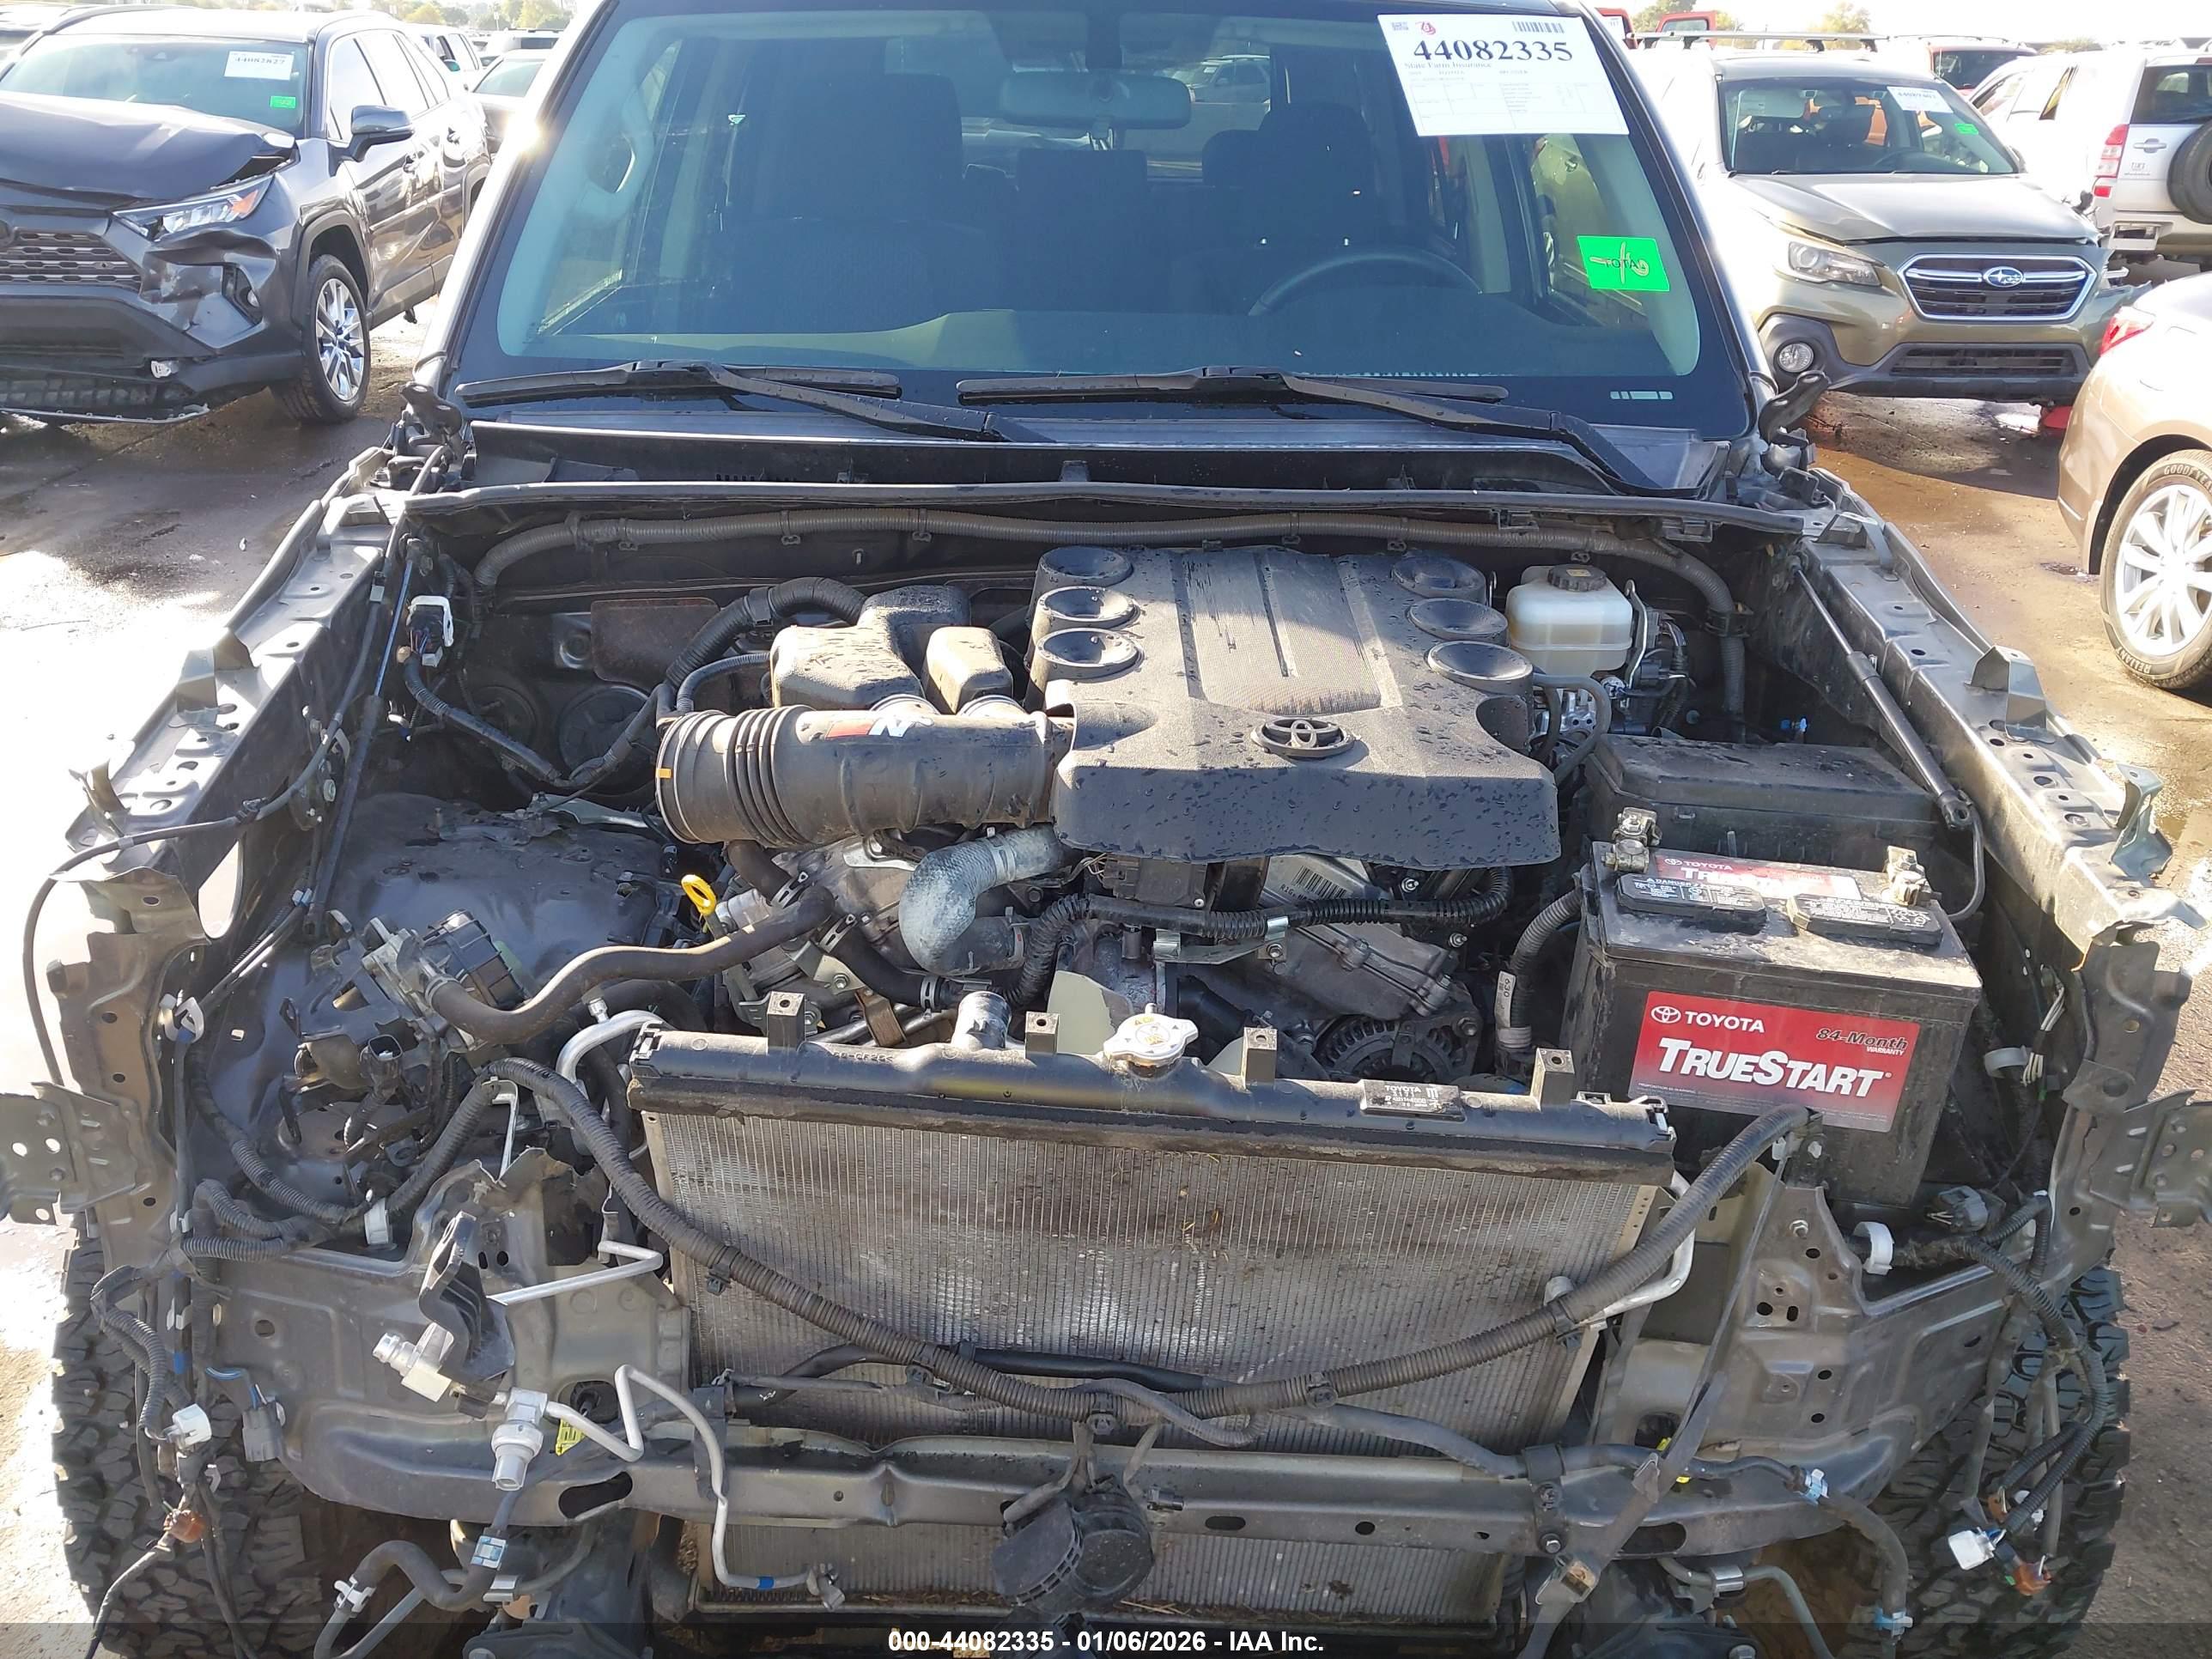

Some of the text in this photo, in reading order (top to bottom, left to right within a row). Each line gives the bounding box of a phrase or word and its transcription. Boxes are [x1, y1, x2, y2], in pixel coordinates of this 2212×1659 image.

[1413, 40, 1572, 61] 44082335
[1683, 860, 1734, 871] TOYOTA
[1684, 1010, 1766, 1034] TOYOTA
[1815, 1027, 1908, 1049] 84-Month
[1866, 1046, 1905, 1056] WARRANTY
[1383, 1085, 1422, 1093] TOYOTA
